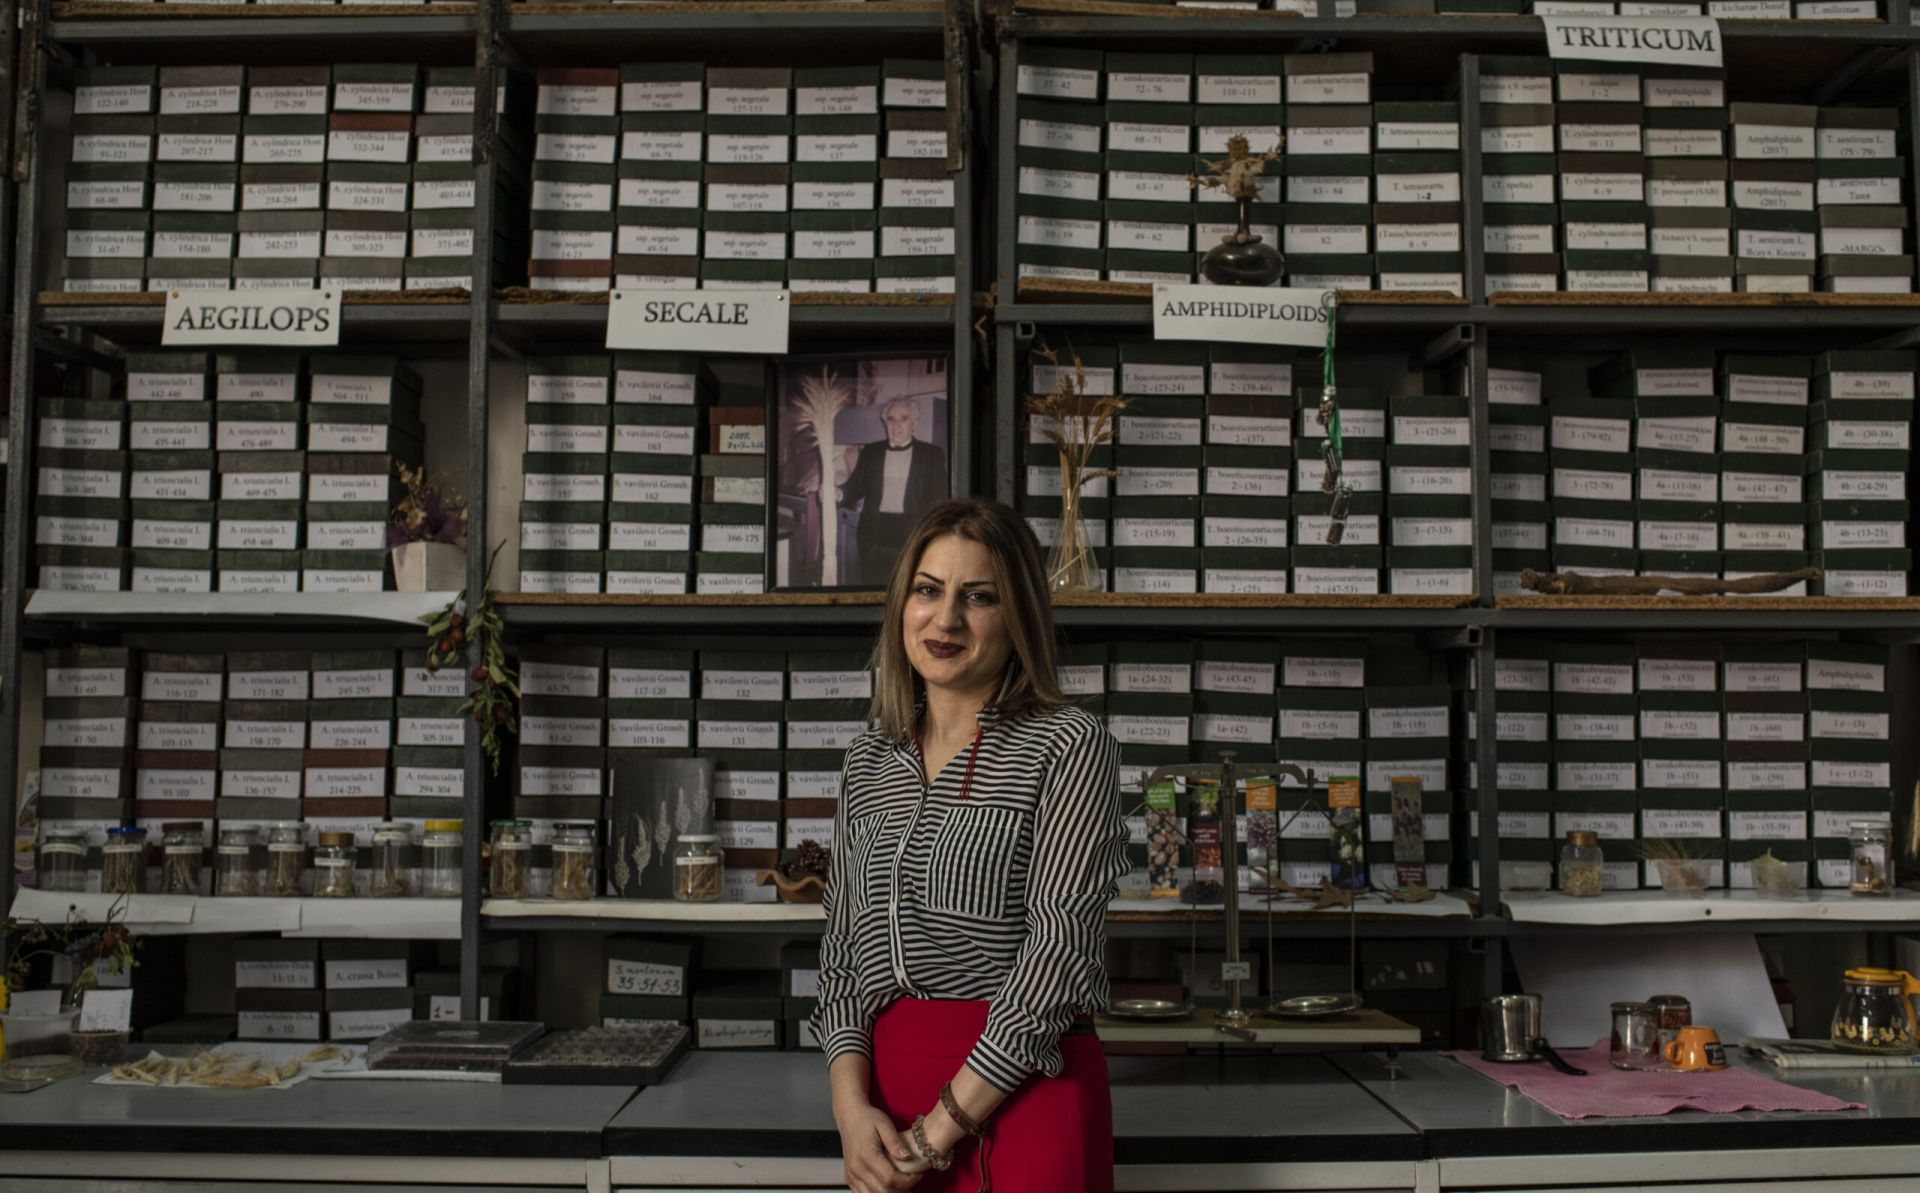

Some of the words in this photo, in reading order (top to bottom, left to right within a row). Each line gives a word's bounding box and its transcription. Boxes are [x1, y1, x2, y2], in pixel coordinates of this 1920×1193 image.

[1556, 26, 1714, 52] TRITICUM
[174, 306, 330, 332] AEGILOPS
[644, 302, 749, 325] SECALE
[1162, 301, 1328, 323] AMPHIDIPLOIDS
